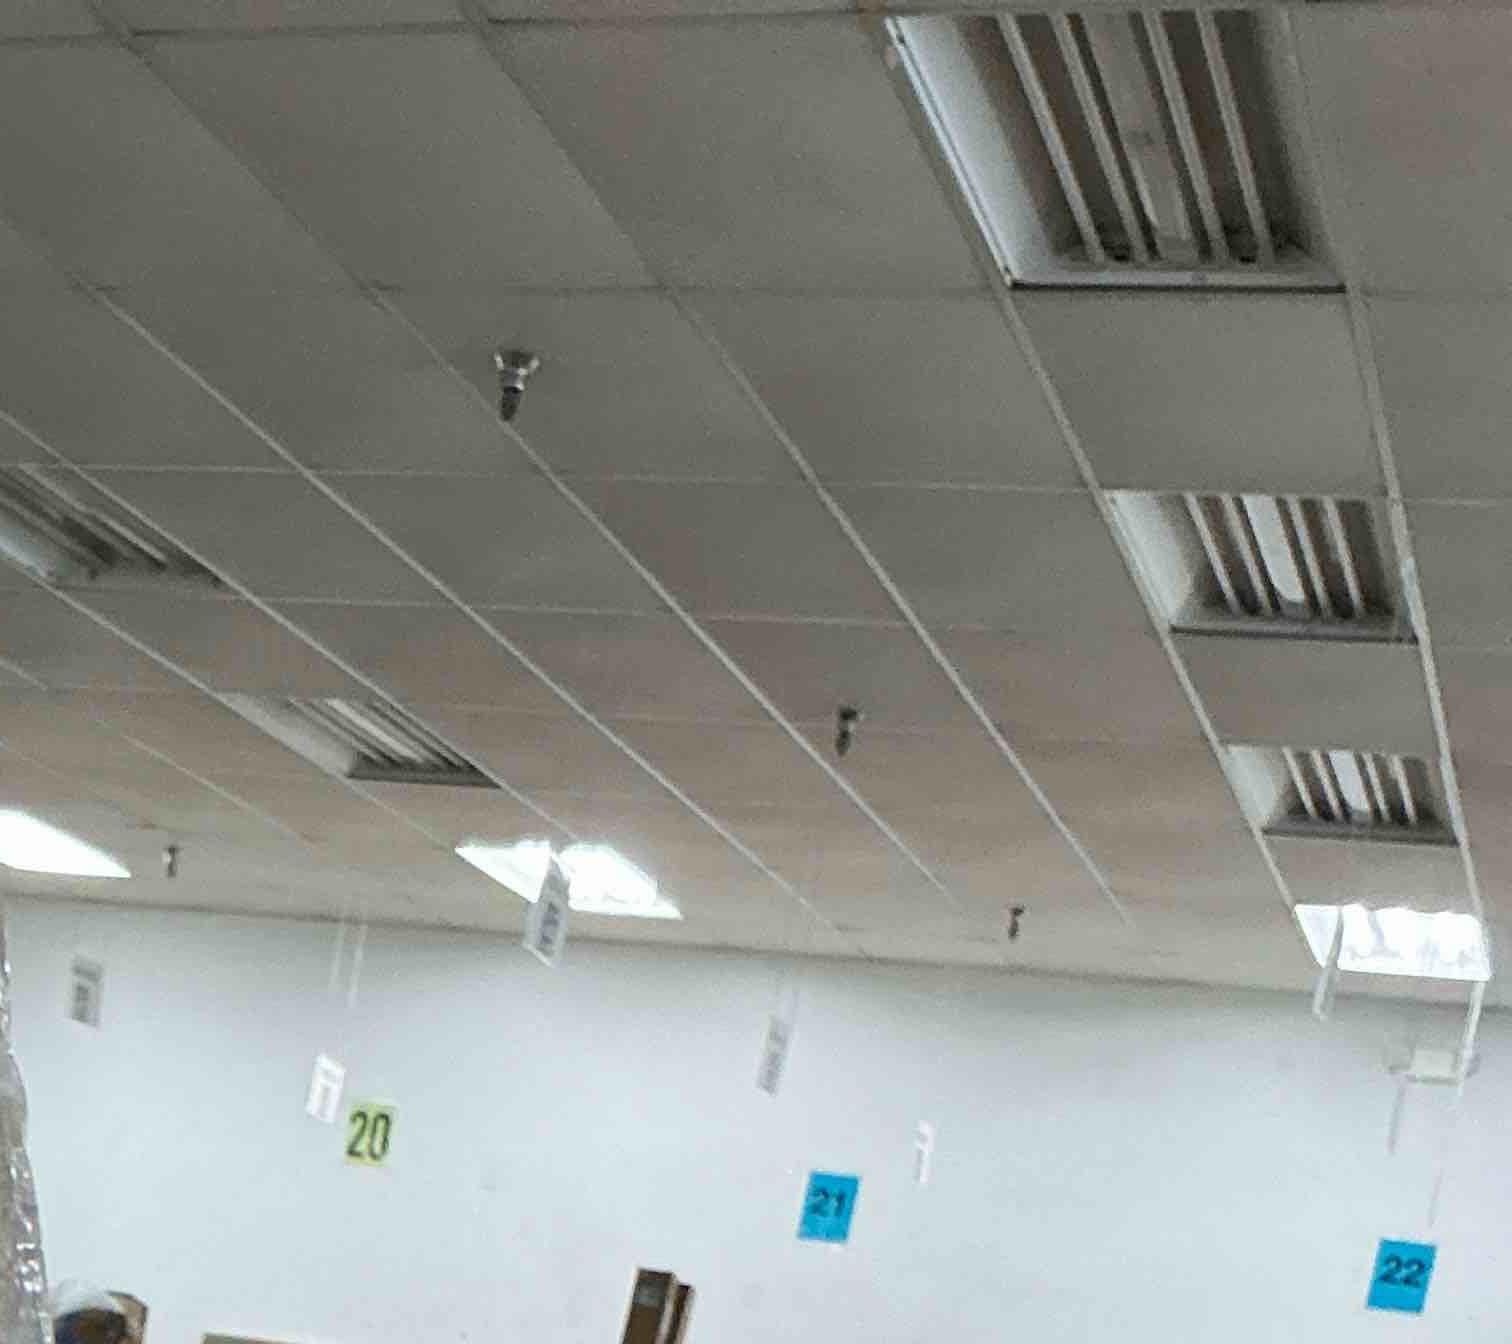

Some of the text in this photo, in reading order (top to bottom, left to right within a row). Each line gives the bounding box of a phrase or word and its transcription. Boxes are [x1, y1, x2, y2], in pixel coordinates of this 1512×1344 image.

[347, 1111, 391, 1161] 20
[809, 1188, 847, 1218] 21
[1378, 1256, 1427, 1288] 22
